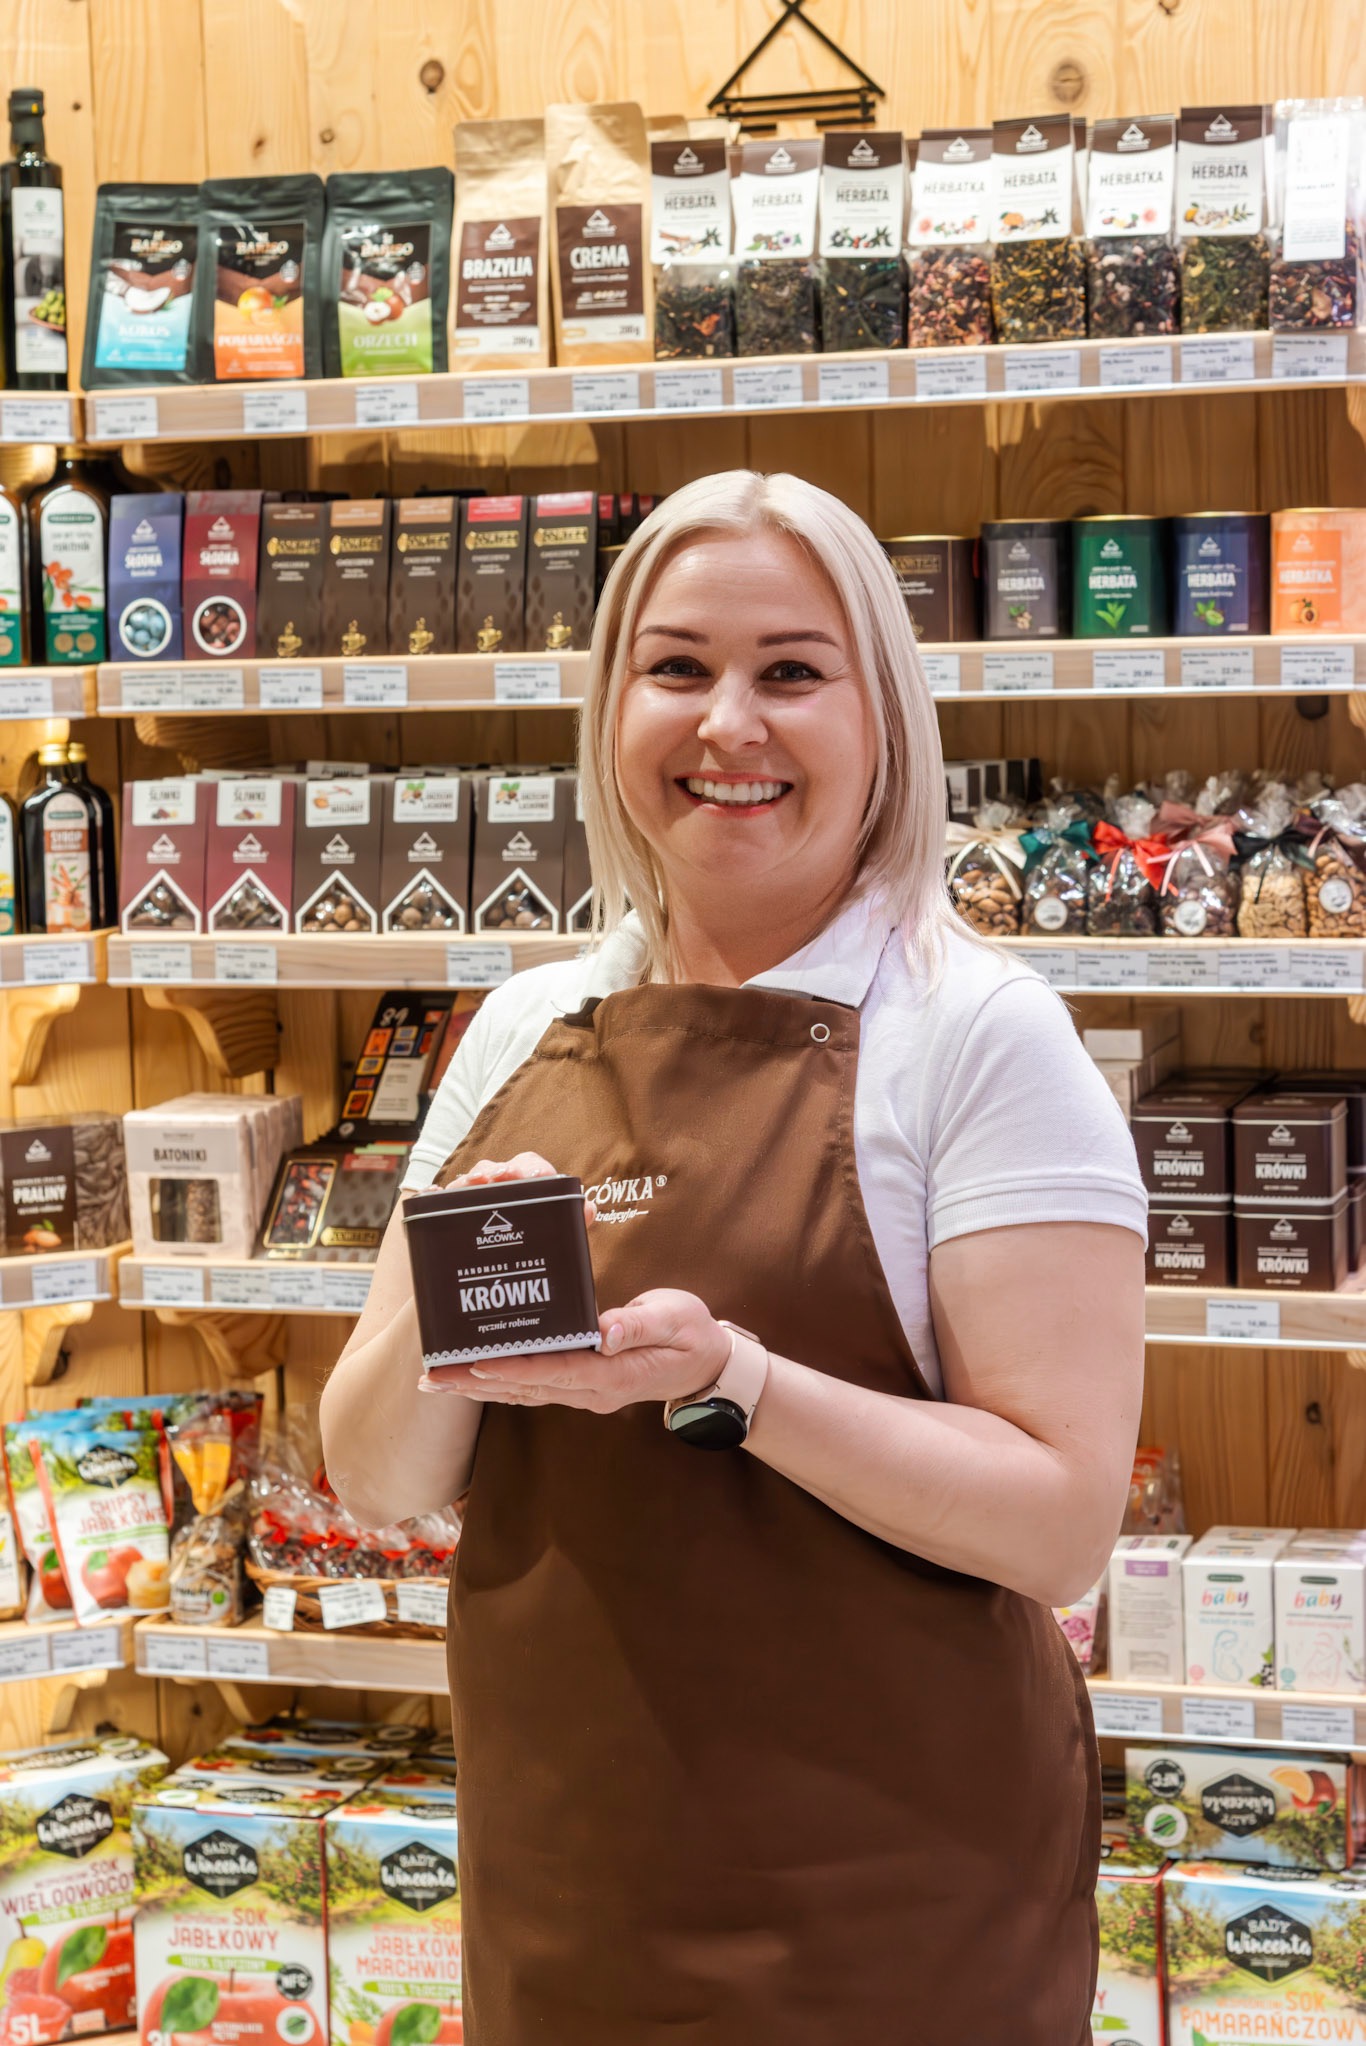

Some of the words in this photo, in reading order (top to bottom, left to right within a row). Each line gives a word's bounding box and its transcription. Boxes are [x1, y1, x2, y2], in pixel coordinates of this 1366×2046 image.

[1003, 172, 1057, 188] HERBATA
[1100, 170, 1164, 186] HERBATKA
[1191, 164, 1248, 181] HERBATA
[836, 188, 889, 203] HERBATA
[923, 181, 985, 194] HERBATKA
[664, 194, 717, 210] HERBATA
[752, 192, 803, 208] HERBATA
[569, 244, 630, 270] CREMA
[462, 256, 534, 280] BRAZYLIA
[353, 332, 418, 349] ORZECH
[997, 576, 1045, 591] HERBATA
[1088, 574, 1137, 589] HERBATA
[1187, 572, 1236, 588] HERBATA
[1279, 569, 1333, 584] HERBATKA
[153, 1148, 207, 1162] BATONIKI
[1154, 1158, 1204, 1176] KRÓWKI
[1255, 1162, 1307, 1180] KRÓWKI
[13, 1184, 67, 1205] PRALINY
[457, 1263, 509, 1277] HANDMADE
[515, 1258, 545, 1269] FUDGE
[1155, 1251, 1206, 1270] KRÓWKI
[1257, 1255, 1309, 1274] KRÓWKI
[460, 1278, 551, 1313] KRÓWKI
[477, 1320, 507, 1334] ręcznie
[508, 1317, 540, 1330] robione
[1202, 1585, 1249, 1608] baby
[1294, 1588, 1342, 1612] baby
[202, 1841, 239, 1856] SADY
[90, 1857, 119, 1875] SOK
[184, 1852, 258, 1875] Wincenta
[399, 1854, 437, 1869] SADY
[380, 1865, 457, 1888] Wincenta
[0, 1872, 135, 1916] WIELOOWOCO
[232, 1907, 268, 1926] SOK
[1248, 1918, 1292, 1934] SADY
[168, 1927, 279, 1951] JABŁKOWY
[369, 1936, 462, 1958] JABŁKOW
[1226, 1931, 1312, 1958] Wincenta
[356, 1956, 461, 1981] MARCHWIO
[281, 1973, 309, 1989] NFC
[1285, 1991, 1327, 2013] SOK
[9, 2013, 50, 2046] 5L
